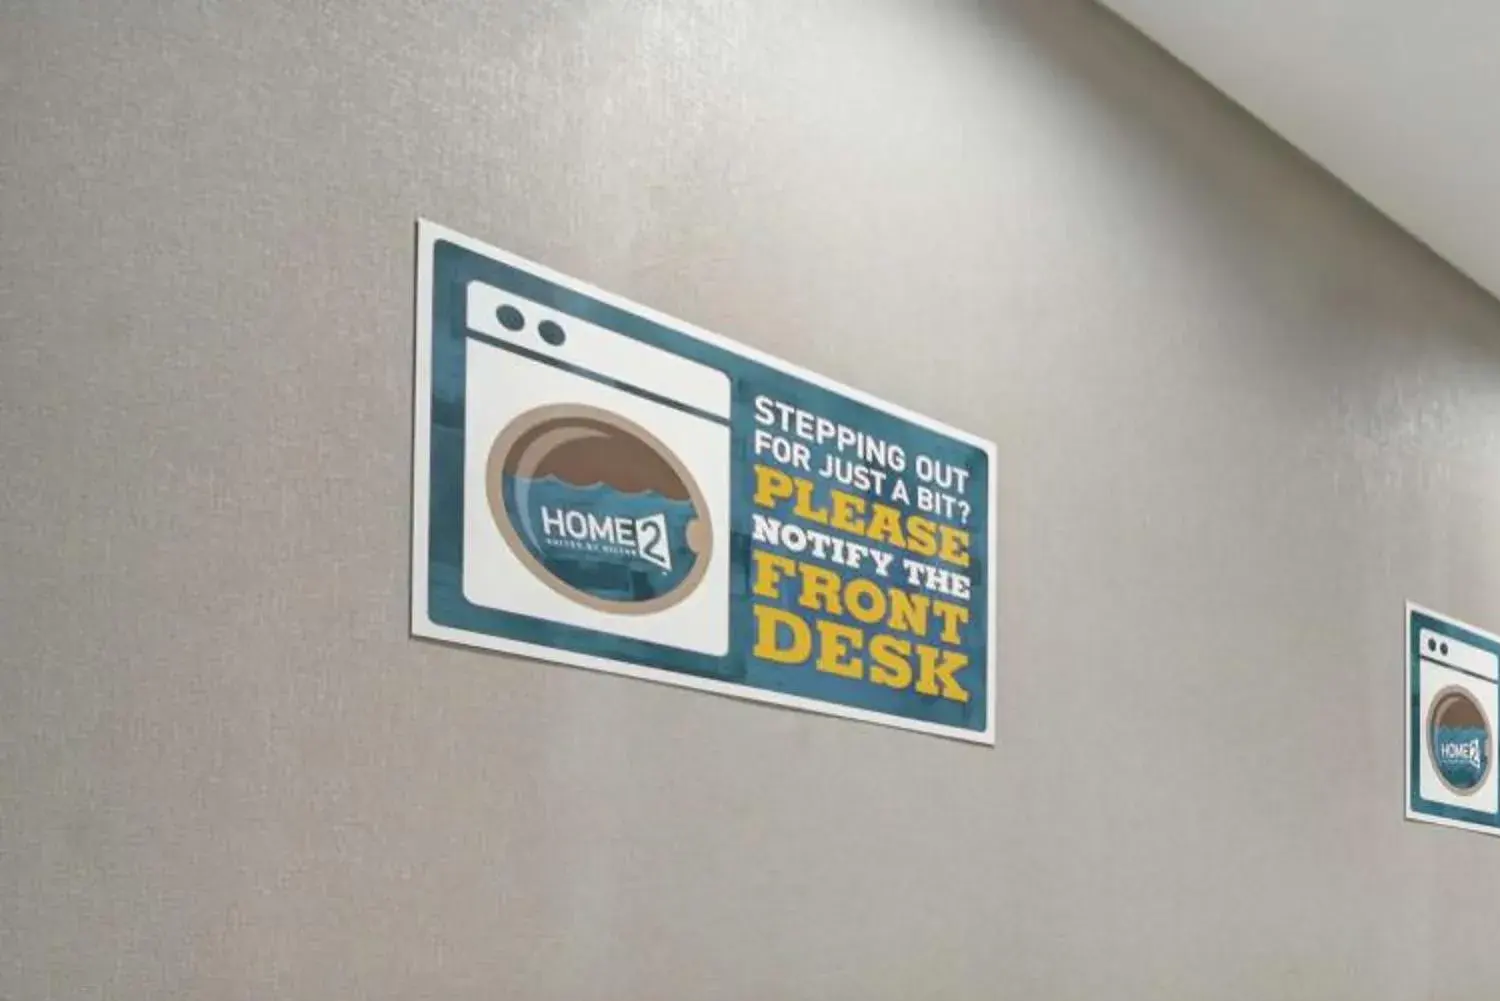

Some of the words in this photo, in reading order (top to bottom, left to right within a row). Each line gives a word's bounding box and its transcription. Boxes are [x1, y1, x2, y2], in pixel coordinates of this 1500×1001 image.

[754, 394, 906, 472] STEPPING
[915, 454, 969, 495] OUT
[754, 428, 811, 472] FOR
[818, 453, 887, 496] JUST
[891, 479, 910, 506] A
[916, 485, 972, 524] BIT?
[752, 514, 893, 577] NOTIFY
[902, 559, 971, 600] THE
[753, 463, 970, 567] PLEASE
[752, 548, 970, 645] FRONT
[752, 603, 970, 704] DESK
